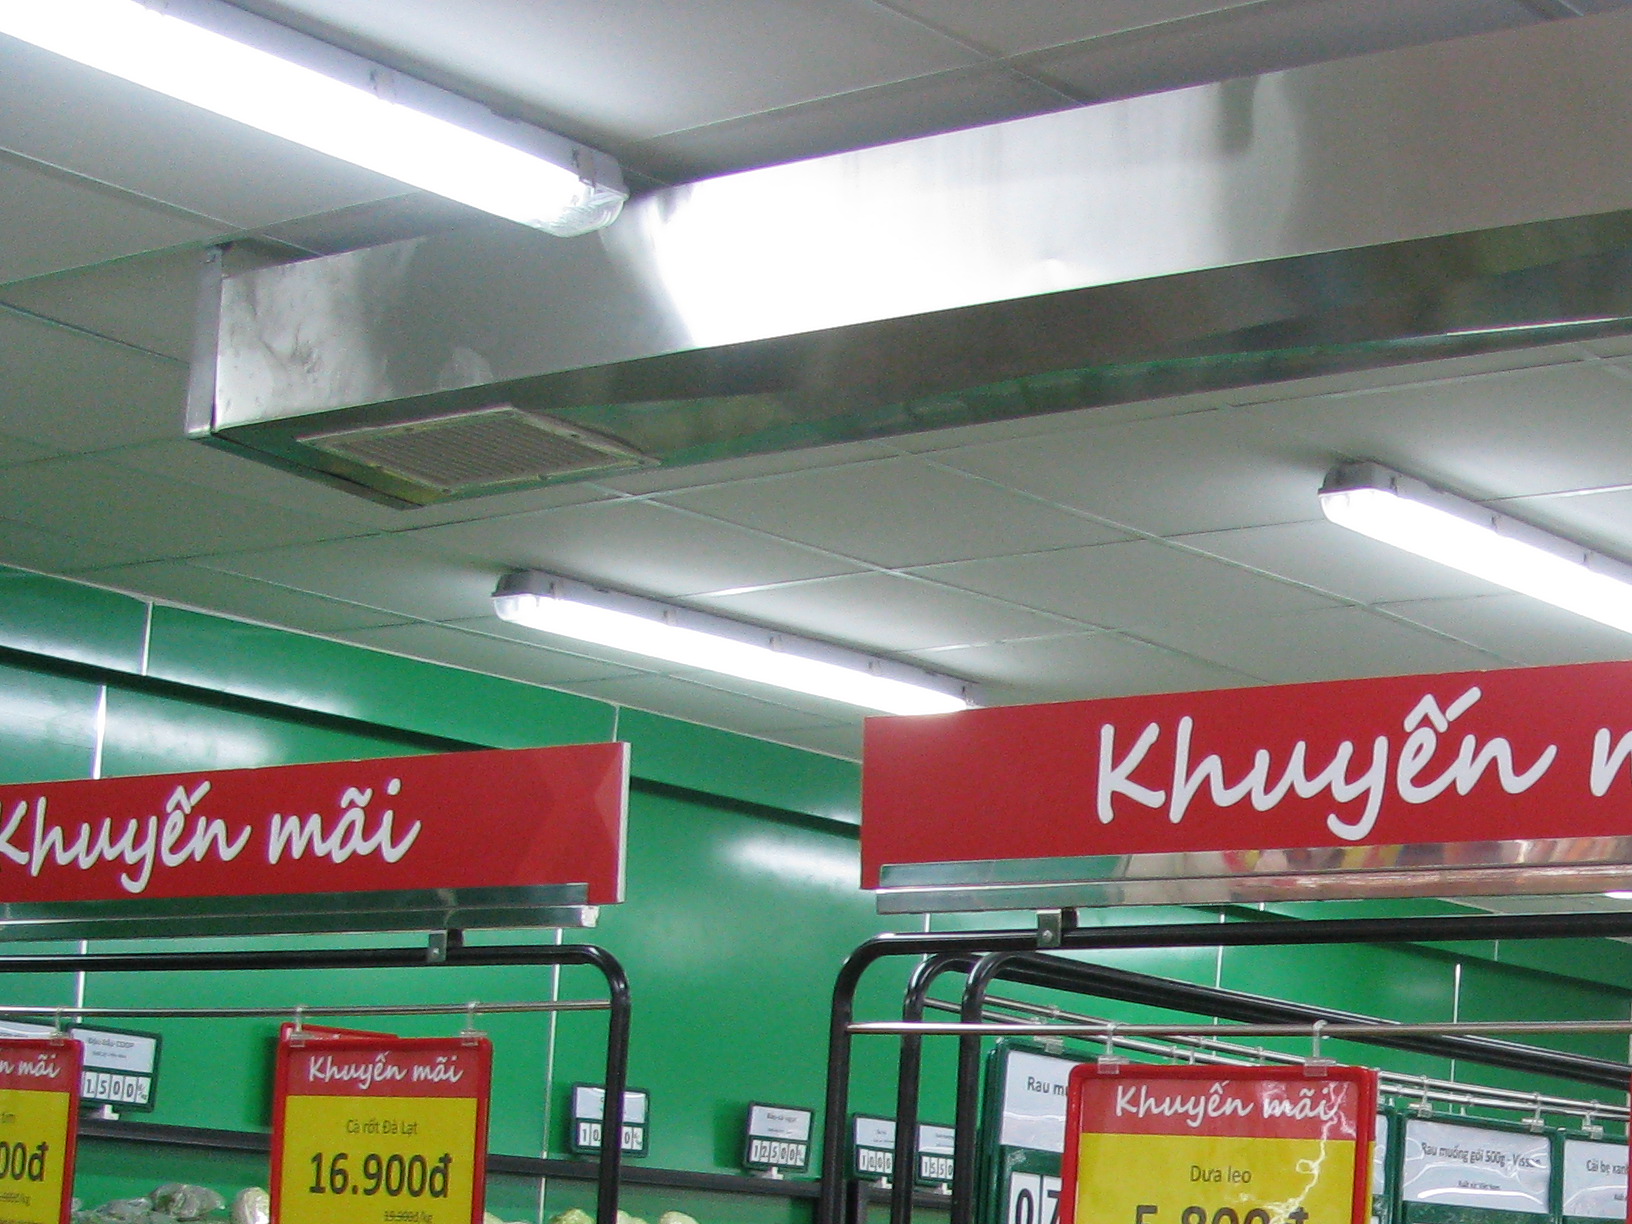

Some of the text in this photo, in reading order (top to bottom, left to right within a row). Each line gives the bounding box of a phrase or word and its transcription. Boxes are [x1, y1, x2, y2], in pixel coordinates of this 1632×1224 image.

[1097, 686, 1556, 841] Khuyến
[269, 778, 421, 864] mãi
[18, 1054, 61, 1078] mãi
[309, 1051, 463, 1089] Khuyến mãi
[1027, 1076, 1049, 1094] Rau
[1115, 1081, 1338, 1127] Khuyến mãi
[309, 1152, 453, 1198] 16.900đ
[1190, 1165, 1251, 1184] Dưa leo
